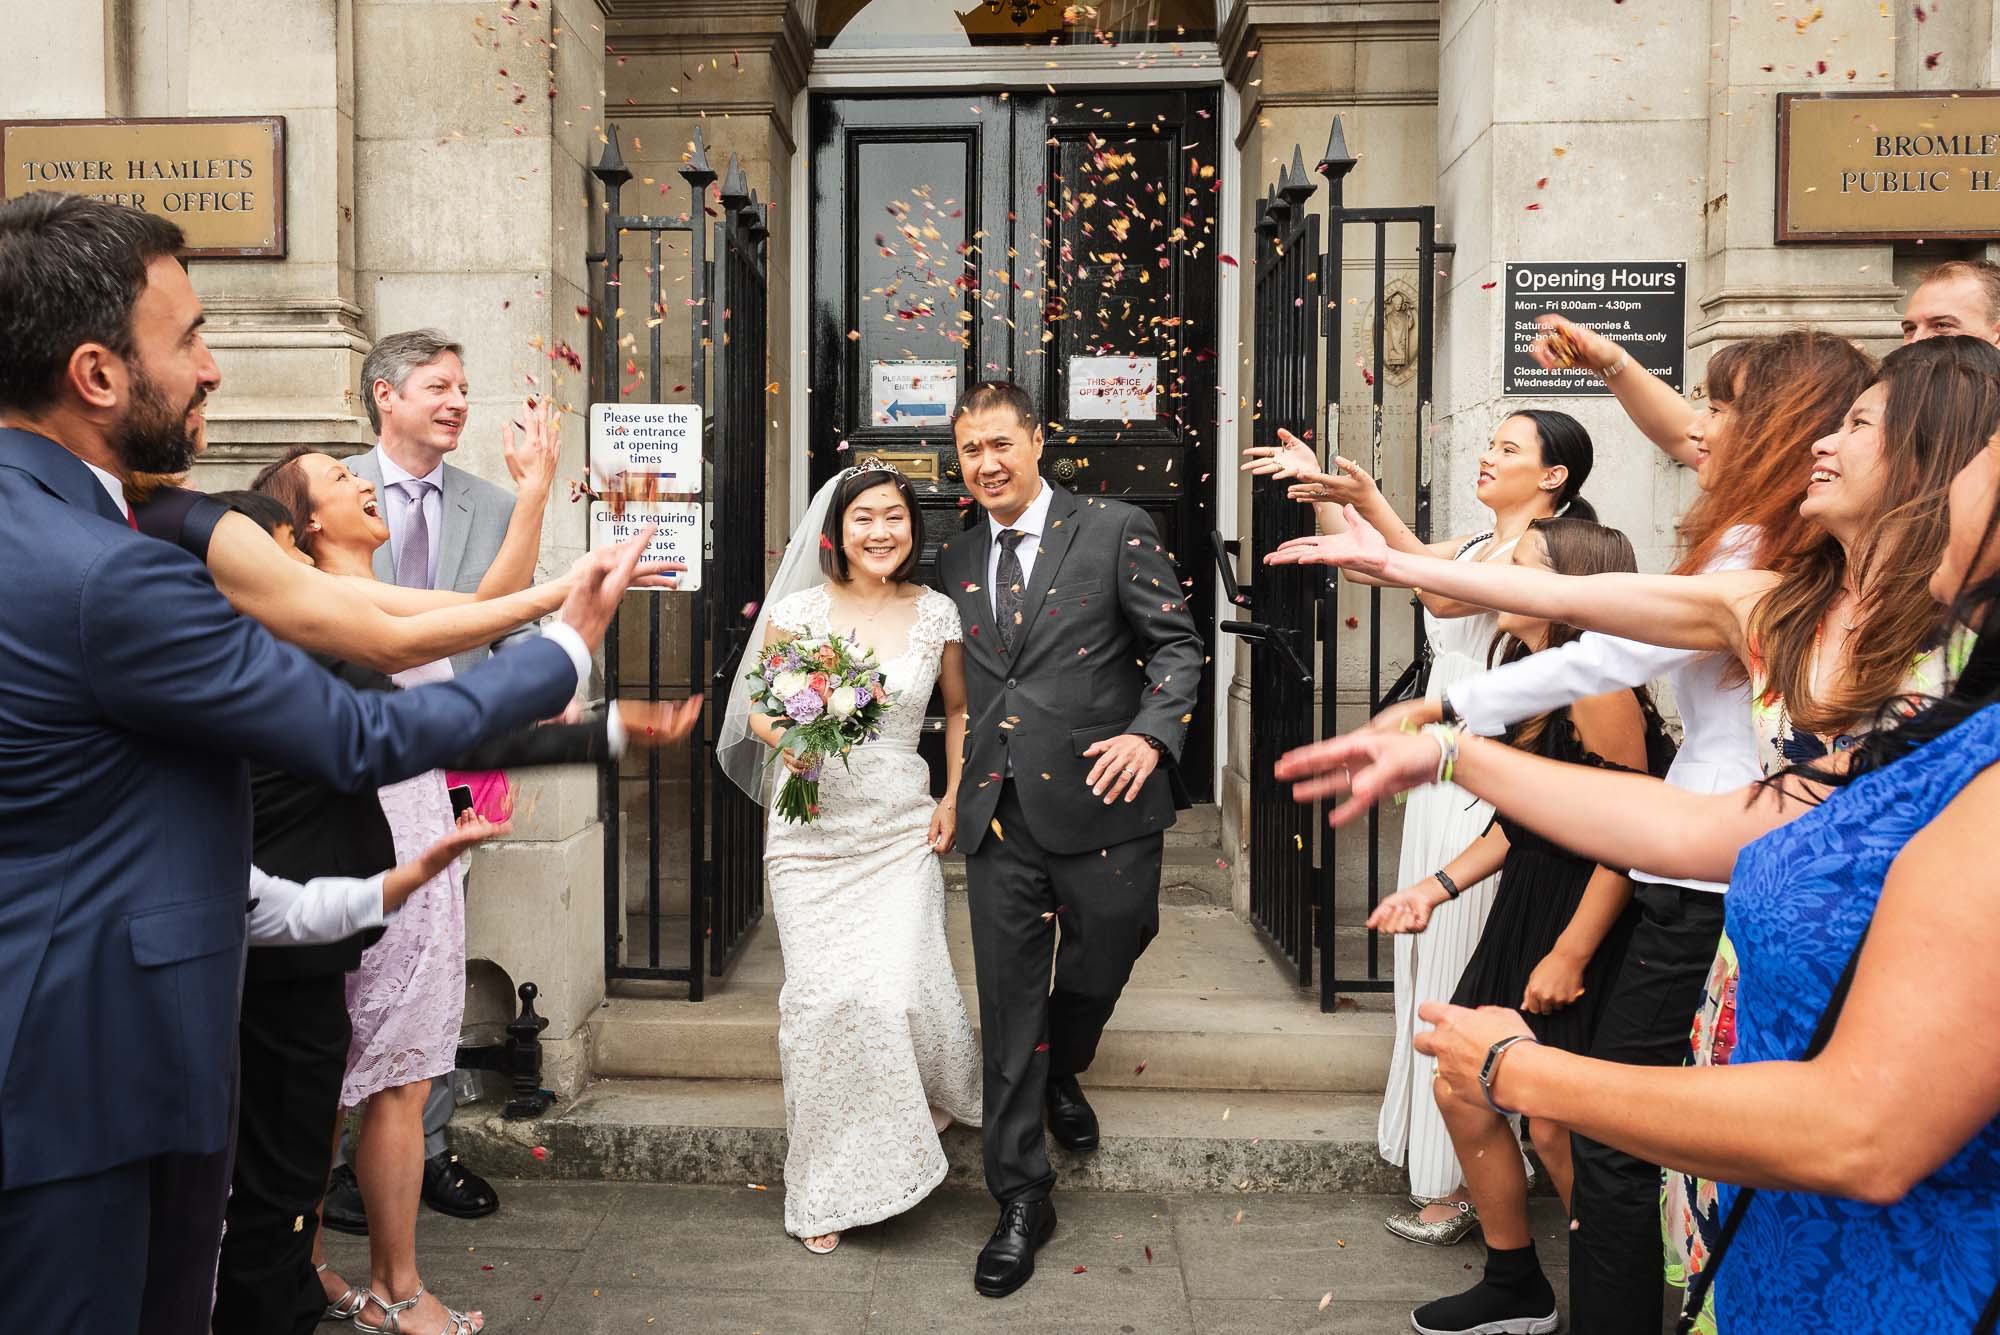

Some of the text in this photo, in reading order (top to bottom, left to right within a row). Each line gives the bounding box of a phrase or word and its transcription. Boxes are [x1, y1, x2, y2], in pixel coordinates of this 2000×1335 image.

[1873, 135, 2000, 157] BROMLE
[23, 159, 254, 182] TOWER HAMLETS
[1840, 169, 1949, 193] PUBLIC
[163, 191, 255, 213] OFFICE
[1516, 269, 1676, 291] Opening Hours
[1514, 301, 1537, 310] Mon
[1546, 301, 1559, 310] Fri
[1561, 301, 1597, 310] 9.00am
[1605, 301, 1641, 312] 4.30pm
[1514, 321, 1631, 331] Saturda eremonies &
[1646, 332, 1667, 343] only
[1514, 366, 1549, 376] Closed
[1550, 367, 1562, 376] at
[1563, 366, 1596, 376] midda
[1087, 378, 1106, 386] THIS
[1514, 378, 1572, 388] Wednesday
[1574, 378, 1585, 387] of
[1112, 388, 1125, 396] AT
[603, 412, 688, 423] Please use the
[606, 426, 686, 437] side entrance
[613, 440, 678, 454] at opening
[630, 453, 662, 464] times
[596, 512, 637, 523] Clients
[640, 512, 696, 526] requiring
[613, 525, 629, 536] lift
[656, 541, 676, 550] use
[640, 553, 686, 563] ntrance
